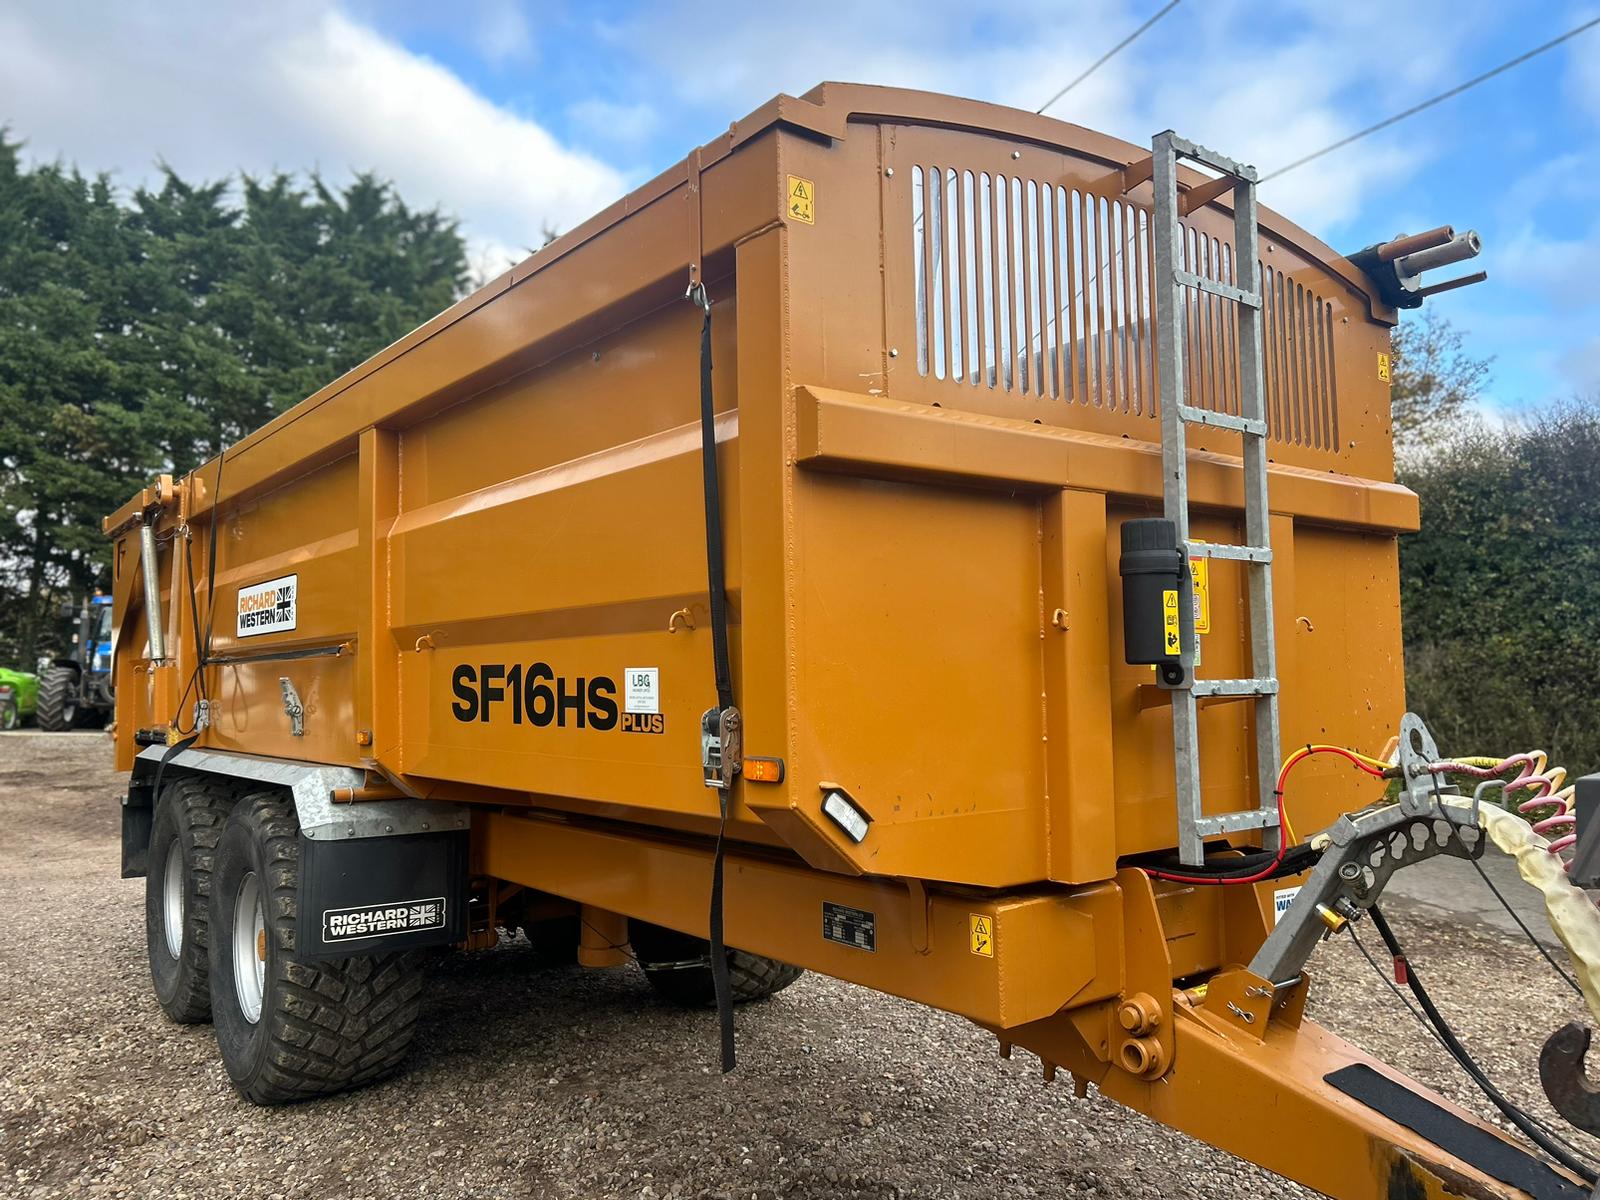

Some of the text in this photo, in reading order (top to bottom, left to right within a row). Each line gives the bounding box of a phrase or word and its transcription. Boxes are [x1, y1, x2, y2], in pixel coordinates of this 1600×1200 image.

[240, 590, 276, 613] RICHARD
[240, 608, 276, 629] WESTERN
[632, 674, 651, 687] LBG
[452, 662, 664, 734] SF16HS PLUS
[330, 908, 408, 926] RICHARD
[330, 918, 408, 936] WESTERN
